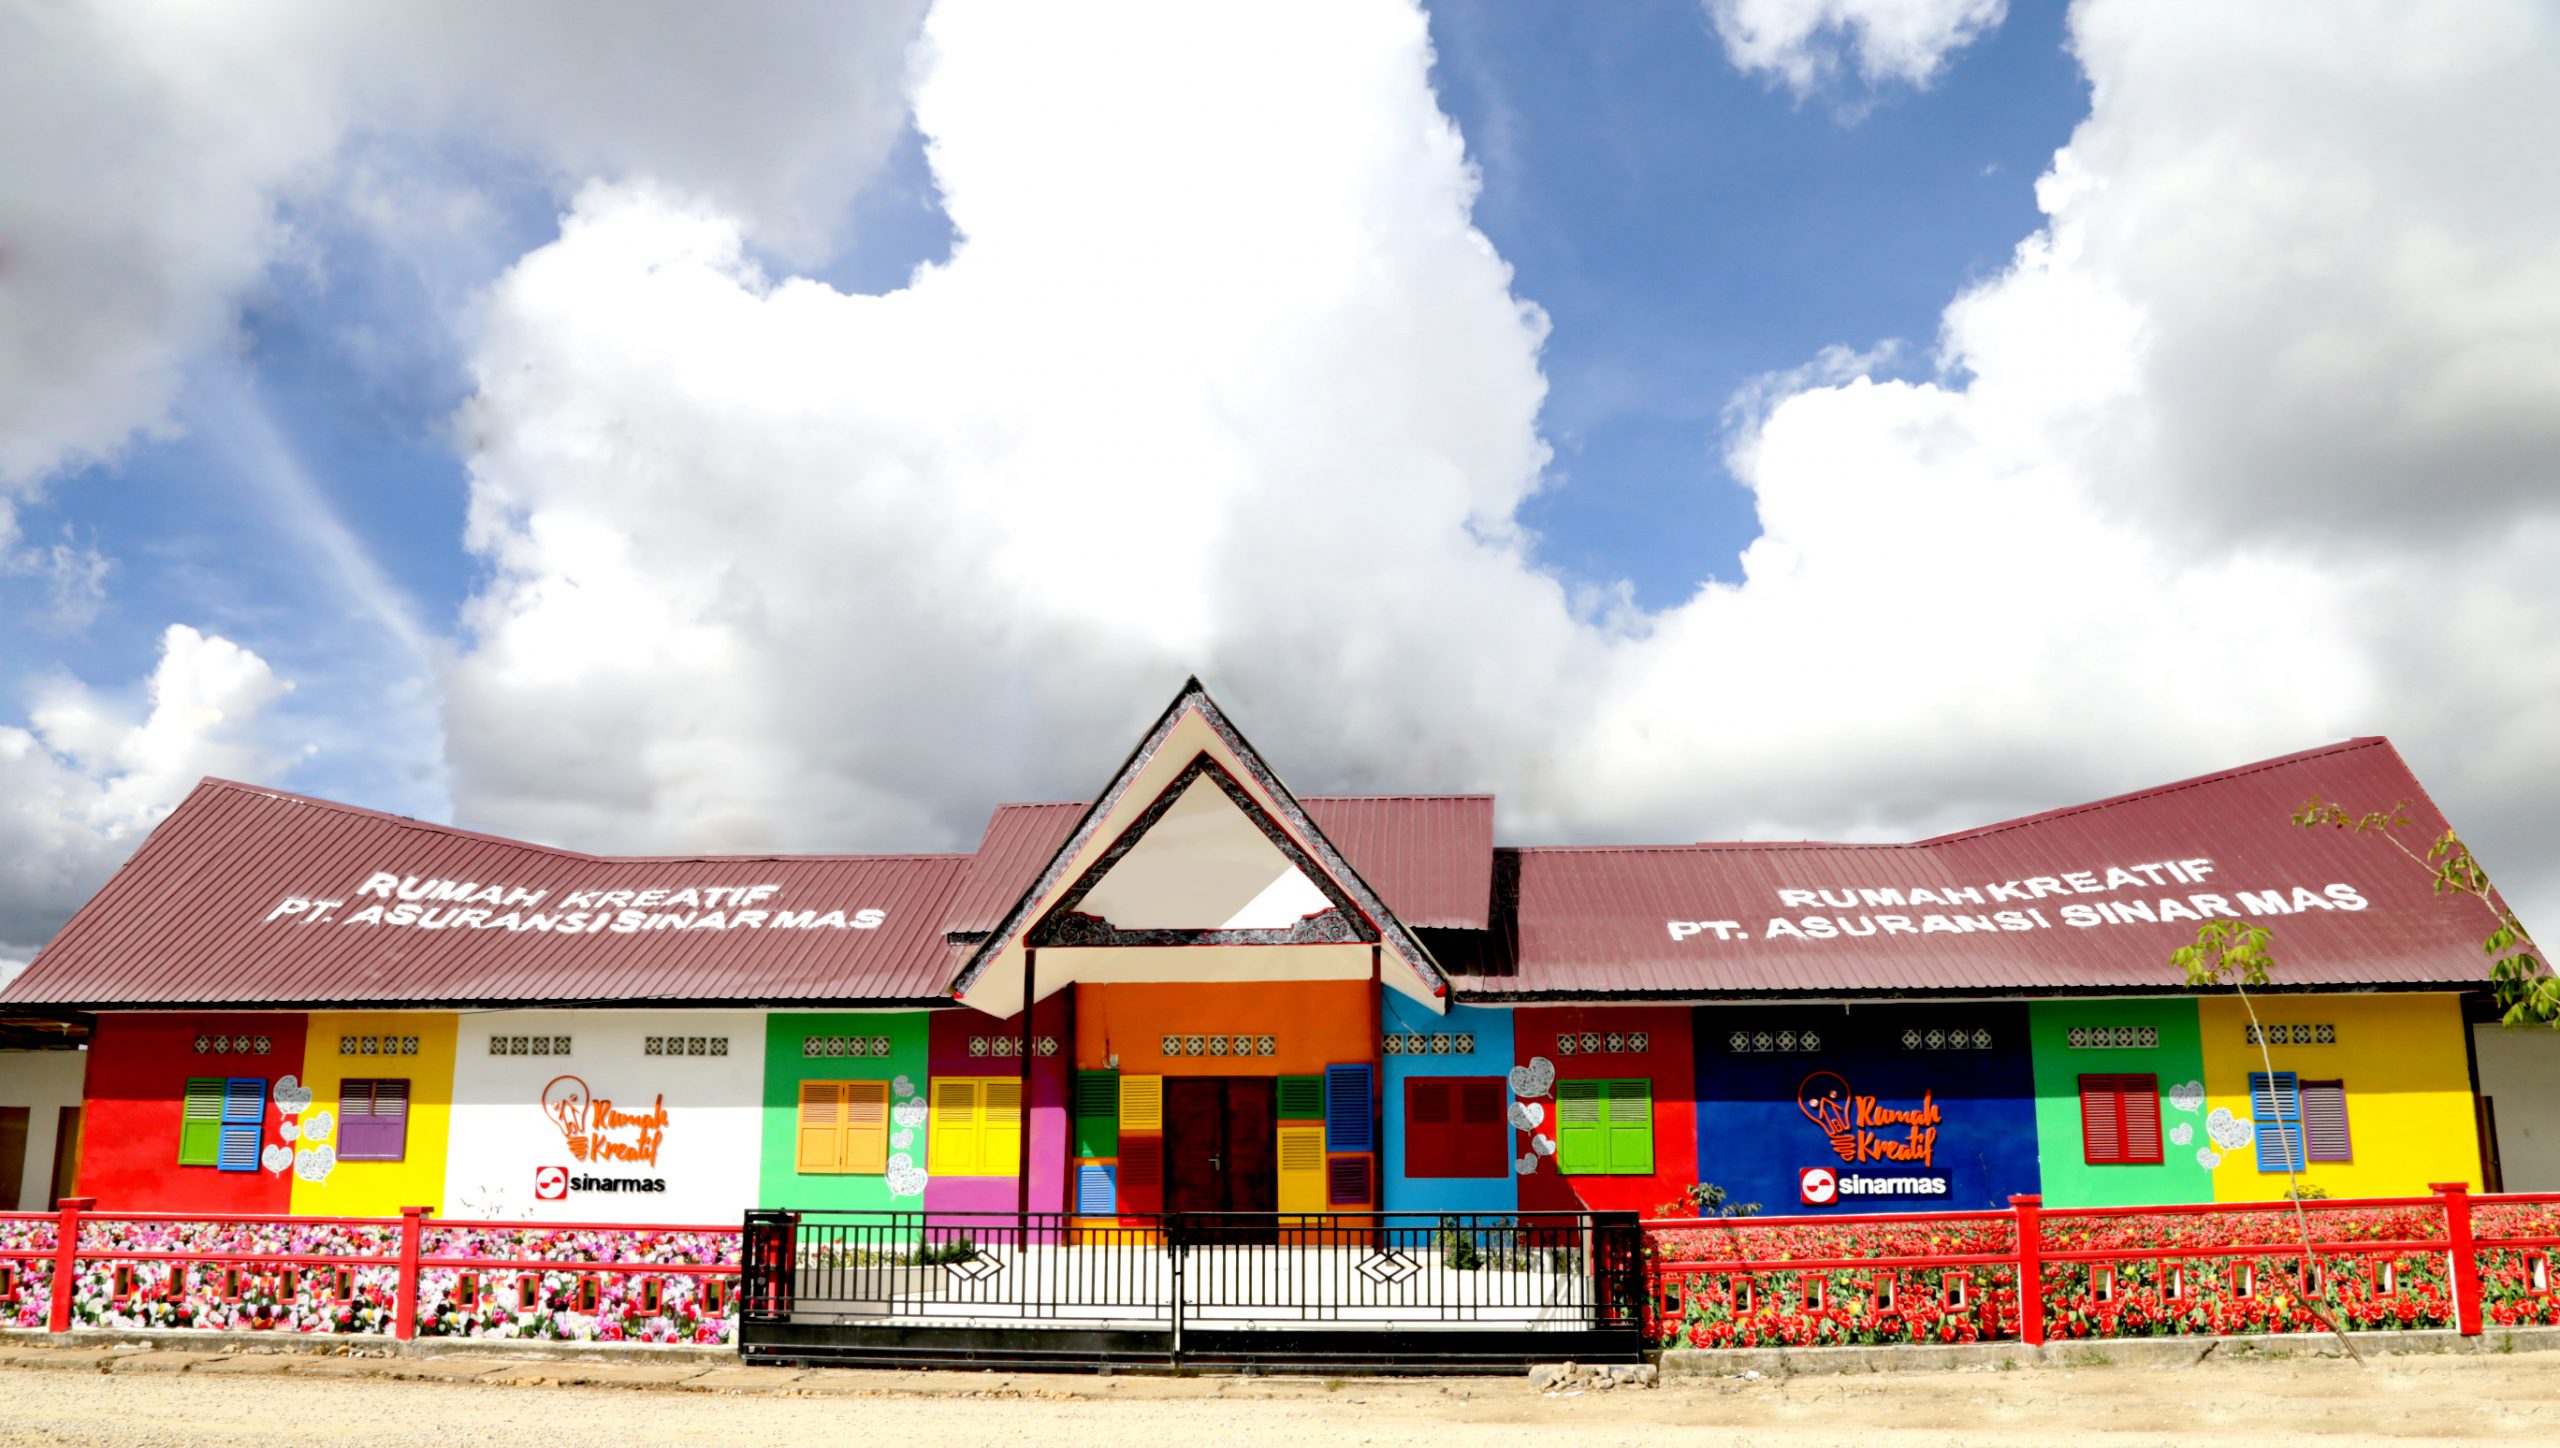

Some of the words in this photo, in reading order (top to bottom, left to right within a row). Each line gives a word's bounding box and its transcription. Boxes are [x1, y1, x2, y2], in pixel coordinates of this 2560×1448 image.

[356, 872, 548, 907] RUMAH
[559, 884, 780, 908] KREATIF
[1777, 887, 1985, 908] RUMAH
[1986, 858, 2214, 902] KREATIF
[264, 897, 343, 923] PT.
[343, 904, 610, 933] ASURANSI
[1667, 920, 1749, 941] PT.
[1765, 908, 2051, 939] ASURANSI
[2060, 894, 2241, 927] SINAR
[2236, 883, 2368, 916] MAS
[592, 1094, 669, 1130] Rumah
[1855, 1089, 1942, 1127] Rumah
[590, 1128, 663, 1168] Kreatif
[1857, 1126, 1937, 1168] Kreatif
[570, 1173, 666, 1192] sinarmas
[1839, 1174, 1947, 1195] sinarmas
